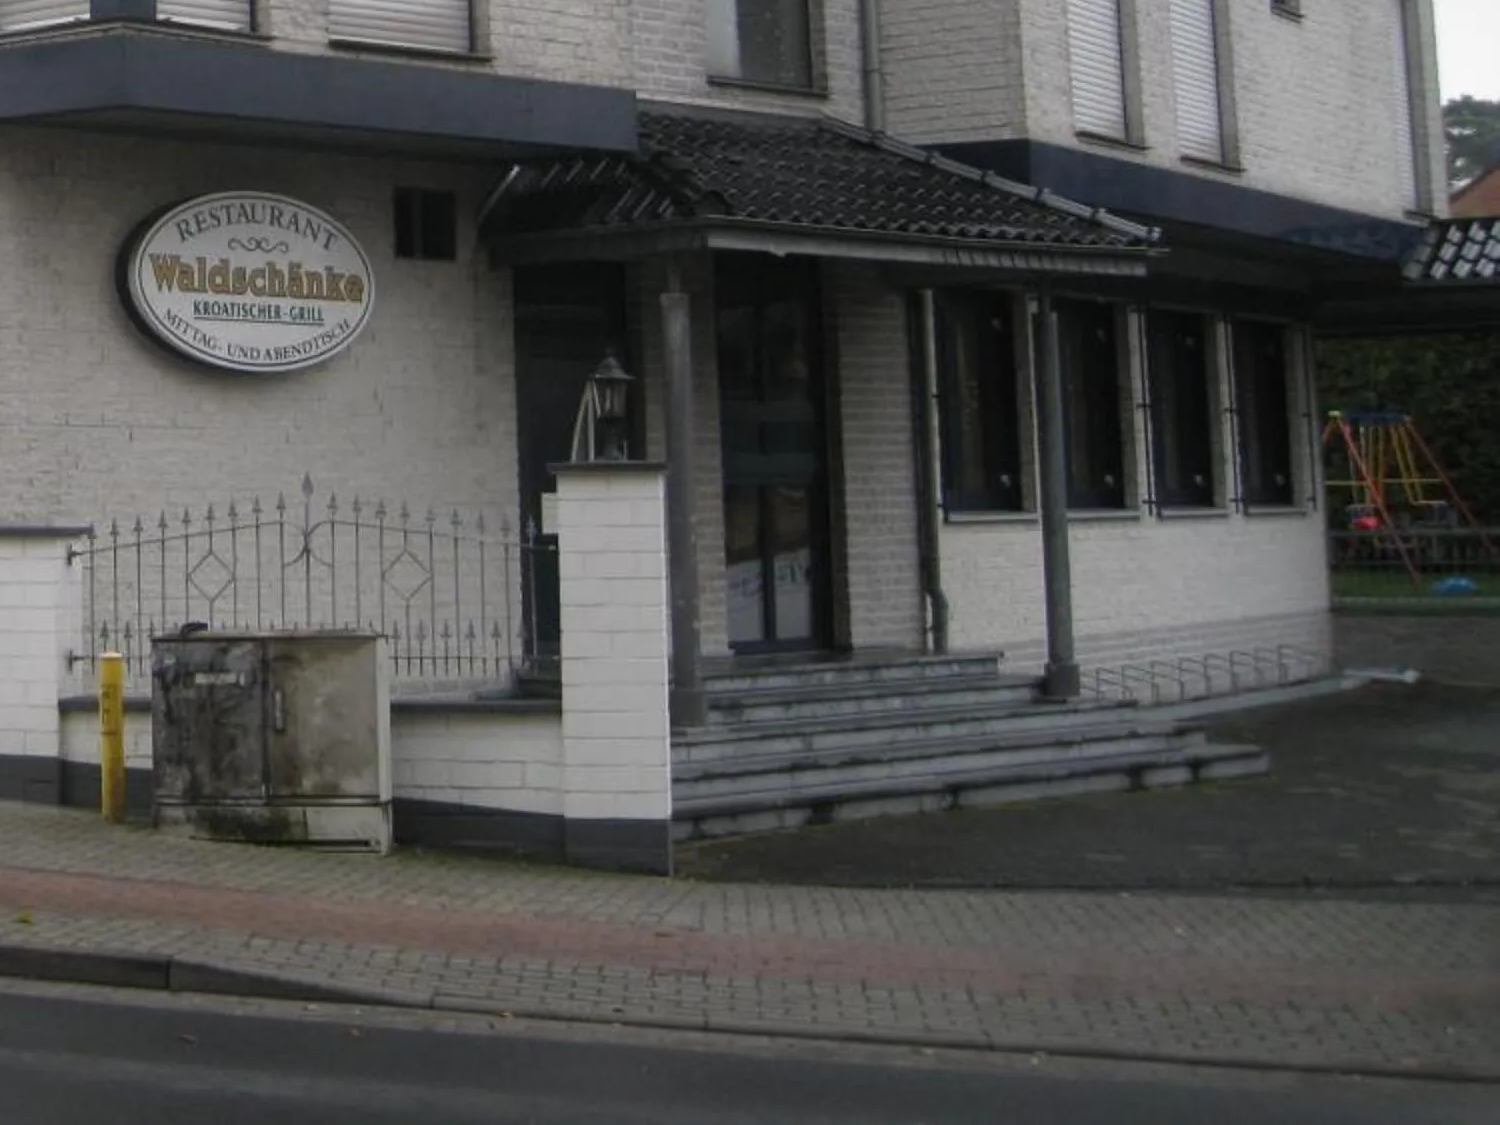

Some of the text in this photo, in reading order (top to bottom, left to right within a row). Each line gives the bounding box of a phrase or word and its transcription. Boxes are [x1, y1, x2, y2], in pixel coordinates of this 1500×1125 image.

[176, 203, 339, 251] RESTAURANT
[148, 253, 365, 304] Waldschänke
[227, 344, 260, 361] UND
